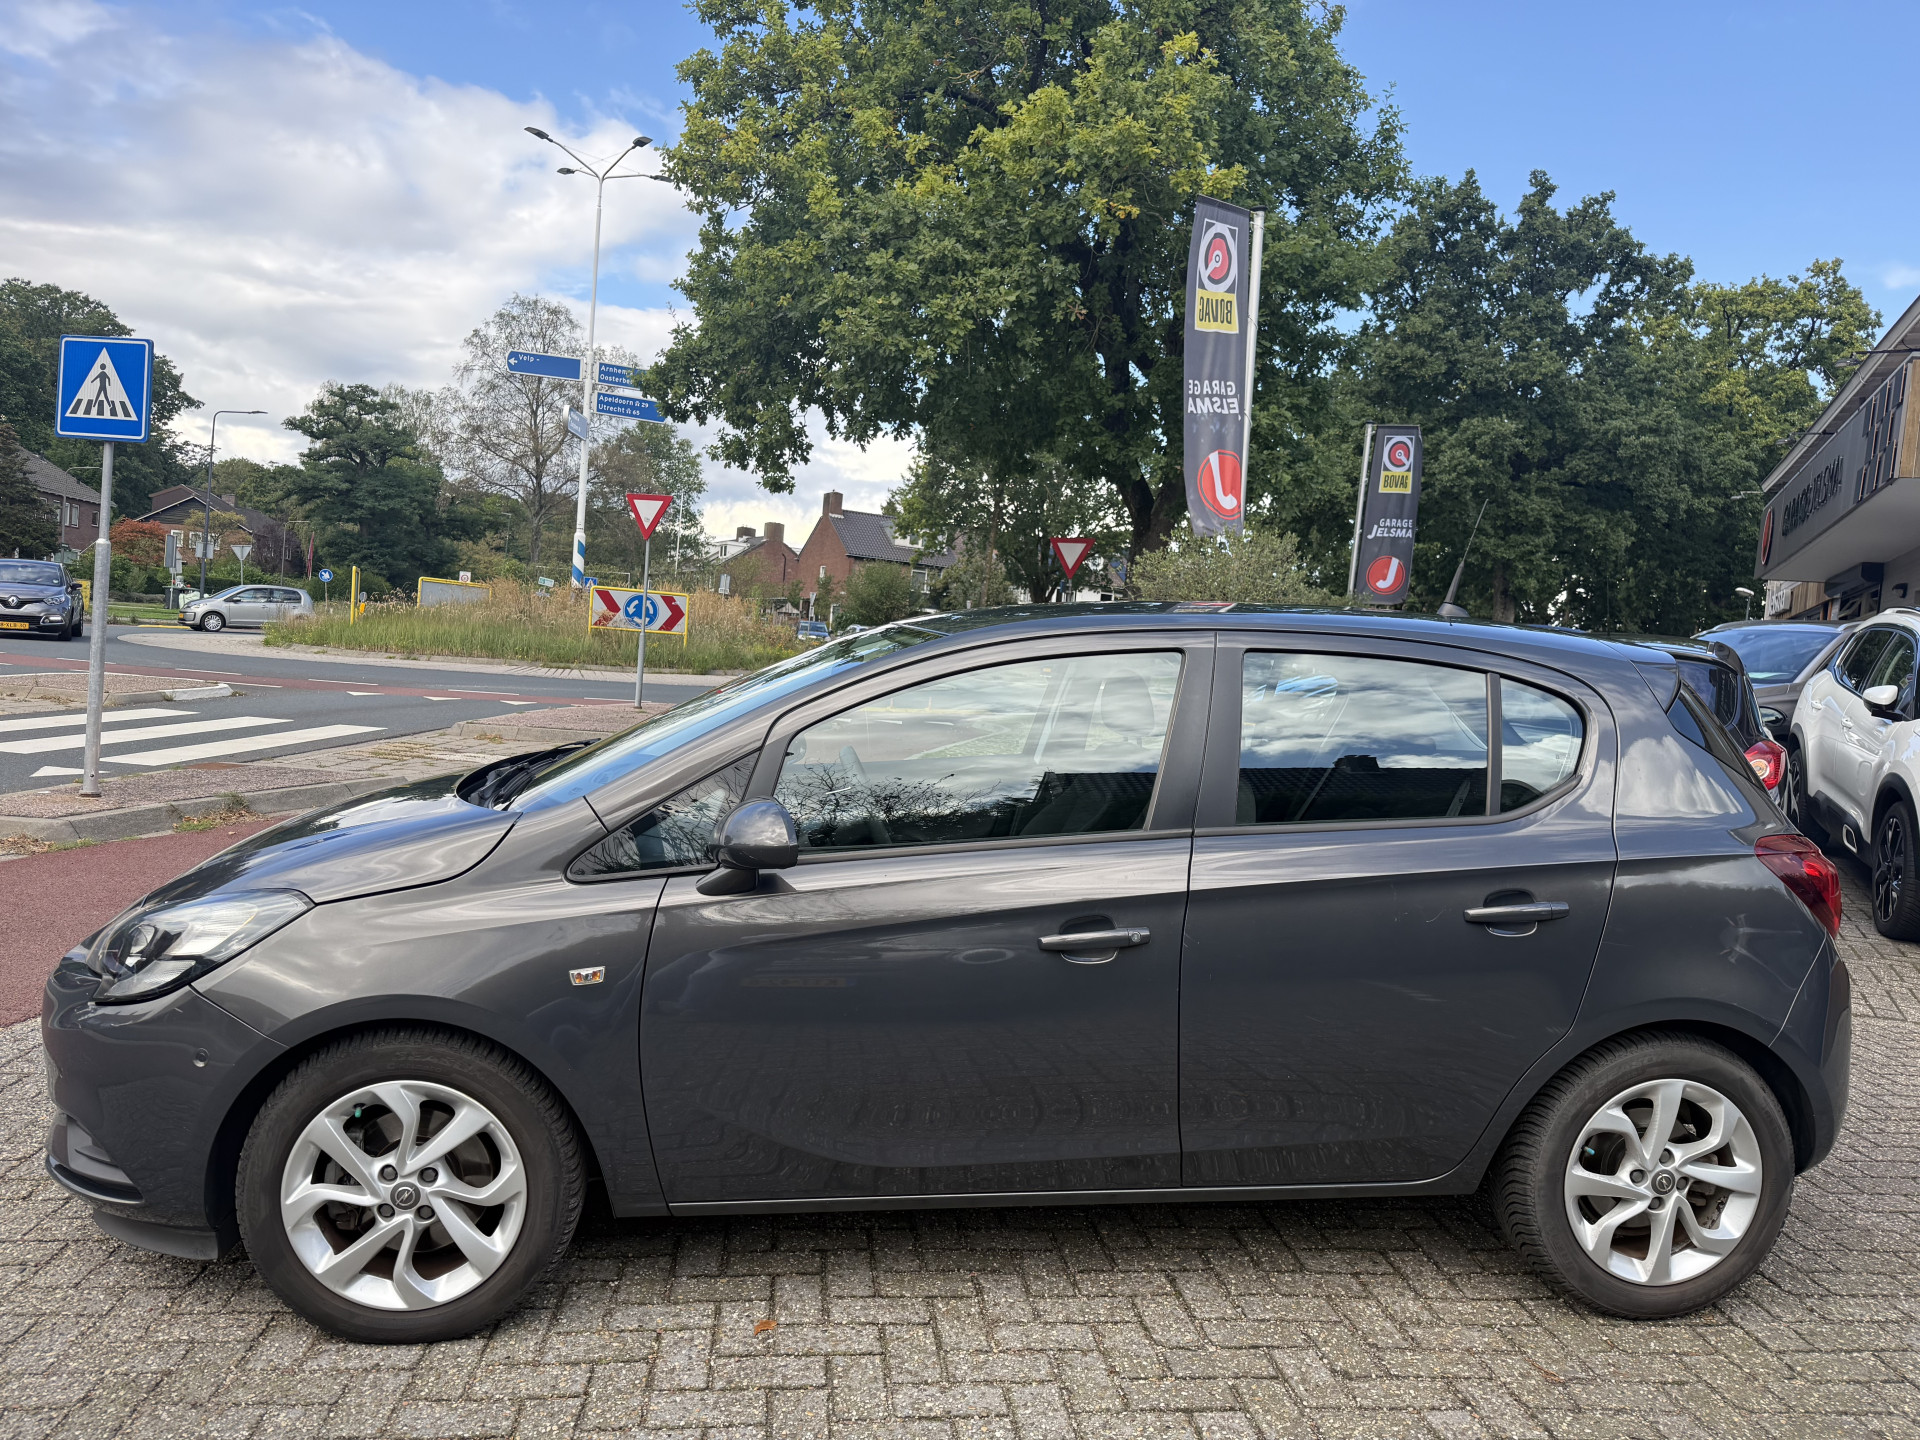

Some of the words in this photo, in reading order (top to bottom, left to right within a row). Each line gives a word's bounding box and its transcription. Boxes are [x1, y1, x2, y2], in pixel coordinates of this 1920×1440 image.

[518, 354, 534, 362] Velp
[599, 395, 634, 406] Apeldoorn
[598, 403, 625, 413] Utrecht
[1379, 518, 1413, 528] GARAGE
[1366, 524, 1413, 540] JELSMA
